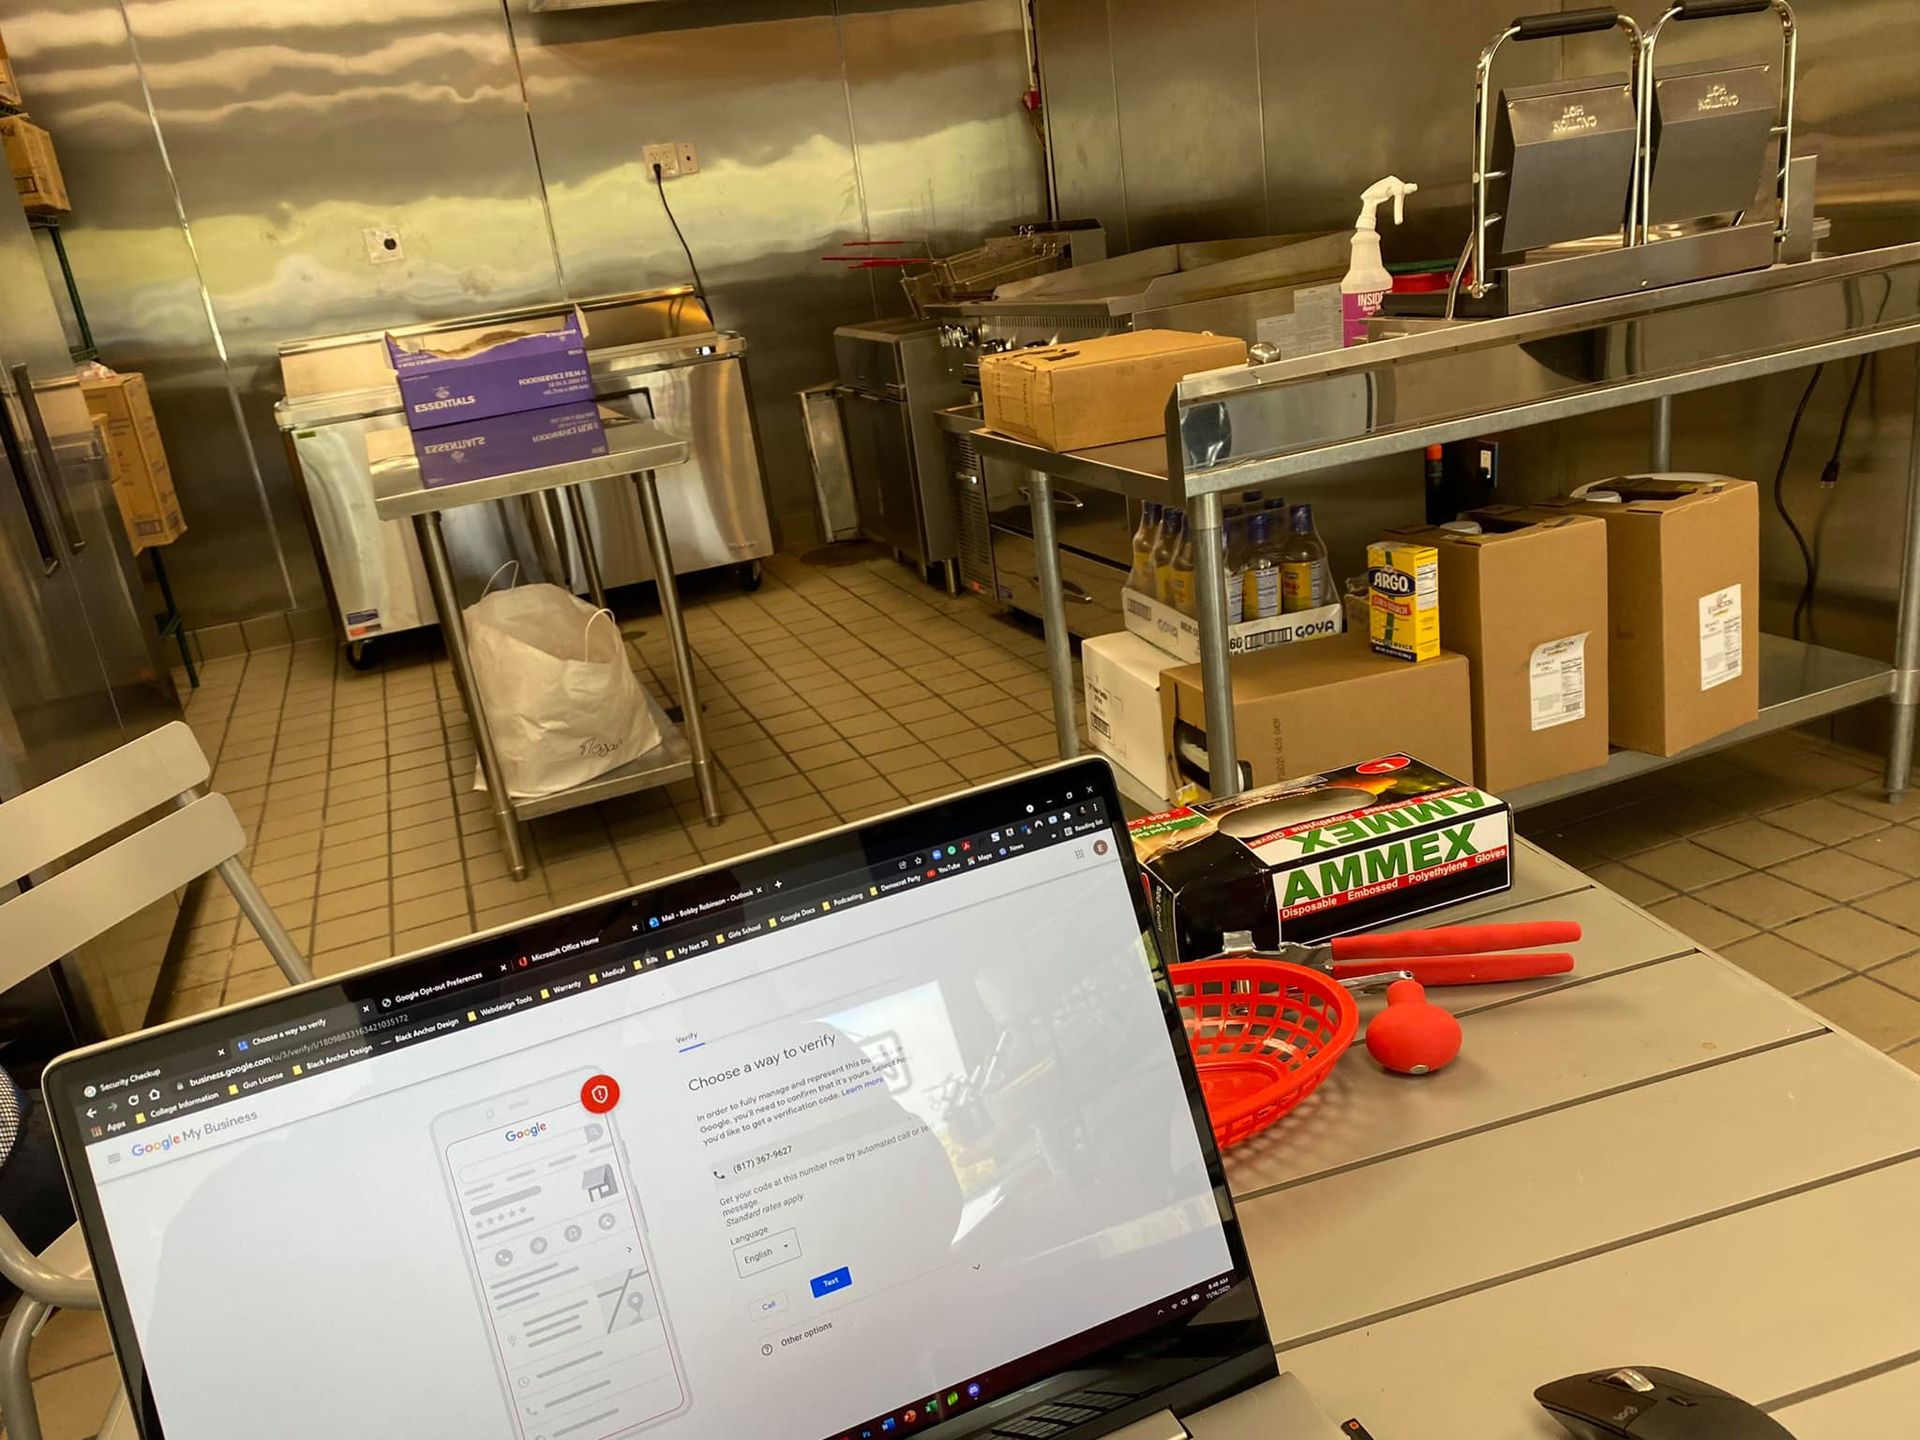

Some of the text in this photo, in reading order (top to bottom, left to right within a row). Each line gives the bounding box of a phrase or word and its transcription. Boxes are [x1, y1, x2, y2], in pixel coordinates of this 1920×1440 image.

[1357, 291, 1383, 306] INSID
[414, 395, 476, 413] ESSENTIALS
[1373, 572, 1409, 593] ARGO
[1295, 620, 1335, 638] GOYA
[1288, 790, 1486, 854] AMMEX
[1282, 823, 1480, 908] AMMEX
[1282, 848, 1506, 919] Disposable Embossed Polyethylene Gloves
[531, 936, 600, 962] Microsoft Office Home
[107, 1121, 126, 1132] Apps
[151, 1104, 177, 1118] College
[179, 1091, 219, 1109] Information
[243, 1080, 257, 1090] Gun
[258, 1072, 284, 1086] License
[306, 1059, 325, 1070] Black
[326, 1052, 349, 1065] Anchor
[350, 1044, 373, 1058] Design
[395, 1032, 413, 1043] Black
[413, 1025, 436, 1038] Anchor
[437, 1018, 459, 1032] Design
[479, 1000, 516, 1017] Webdesign
[516, 995, 533, 1006] Tools
[553, 981, 581, 994] Warranty
[602, 965, 626, 978] Medical
[780, 911, 800, 924] Google
[801, 906, 816, 916] Docs
[834, 892, 864, 906] Podcasting
[881, 876, 907, 892] Democrat
[908, 874, 921, 884] Party
[938, 862, 961, 874] YouTube
[978, 853, 993, 863] Maps
[395, 972, 483, 1003] Google Opt-out Preferences
[252, 1033, 278, 1046] Choose
[285, 1028, 299, 1038] way
[306, 1018, 327, 1031] verify
[676, 1032, 699, 1044] Verify
[688, 1032, 836, 1093] Choose a way to verify
[100, 1069, 161, 1092] Security Checkup
[697, 1060, 860, 1123] In order to fully manage and represent this
[703, 1130, 726, 1146] you'd
[727, 1125, 741, 1137] like
[742, 1122, 751, 1132] to
[752, 1118, 767, 1131] get
[773, 1098, 818, 1121] verification
[841, 1083, 864, 1096] Learn
[864, 1077, 885, 1089] more
[755, 1103, 776, 1115] need
[786, 1089, 817, 1105] confirm
[818, 1082, 834, 1093] that
[132, 1113, 257, 1156] Google My Business
[505, 1121, 547, 1142] Google
[720, 1195, 734, 1206] Get
[734, 1189, 752, 1203] your
[753, 1181, 773, 1195] code
[773, 1178, 783, 1187] at
[783, 1173, 798, 1184] this
[799, 1162, 828, 1178] number
[829, 1156, 845, 1168] now
[846, 1151, 856, 1162] by
[856, 1137, 897, 1157] automated
[897, 1131, 911, 1142] call
[733, 1145, 793, 1175] (817) 367-9627
[722, 1199, 758, 1217] message
[726, 1192, 804, 1227] Standard rates apply
[730, 1226, 769, 1246] Language
[744, 1248, 773, 1265] English
[823, 1276, 839, 1287] Text
[762, 1301, 776, 1311] Call
[781, 1321, 833, 1348] Other options
